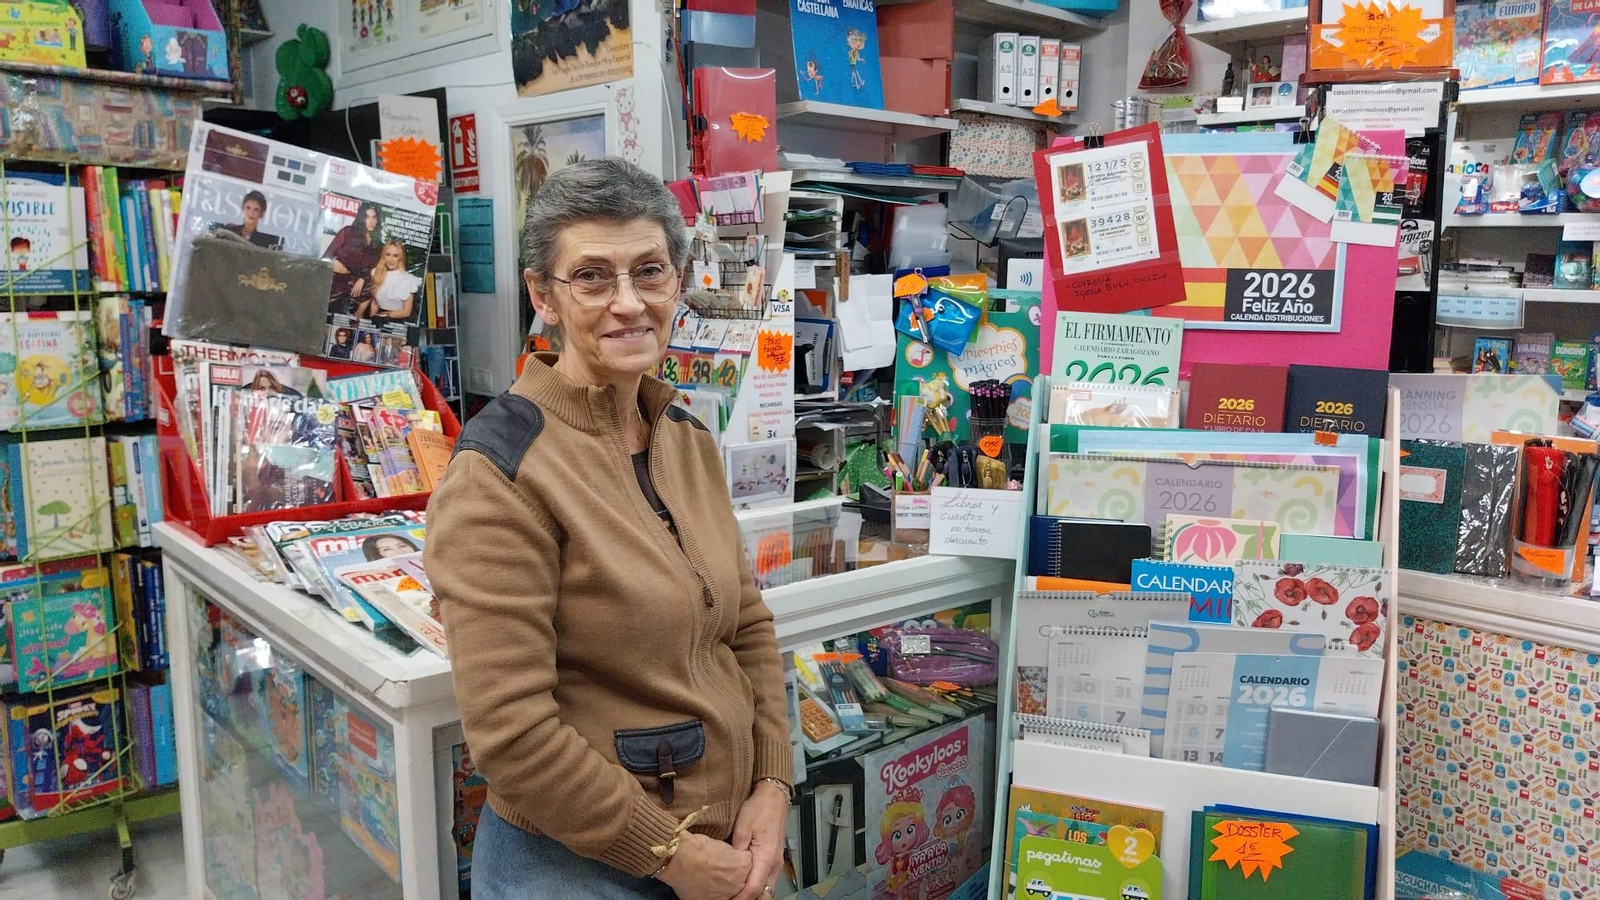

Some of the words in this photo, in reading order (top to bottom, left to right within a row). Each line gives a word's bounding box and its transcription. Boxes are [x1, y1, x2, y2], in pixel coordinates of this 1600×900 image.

[797, 0, 839, 18] CASTELLANA
[1500, 3, 1536, 17] EUROPA
[1332, 106, 1425, 114] cosstorremolinos@gmail.com
[1087, 158, 1127, 173] 12175
[0, 200, 56, 216] VISIBLE
[1090, 212, 1130, 227] 39428
[1400, 229, 1432, 244] ergizer
[1243, 271, 1315, 299] 2026
[772, 304, 791, 313] VISA
[1242, 298, 1279, 313] Feliz
[1281, 299, 1314, 313] Año
[1230, 313, 1264, 321] CALENDA
[1265, 314, 1325, 323] DISTRIBUCIONES
[1065, 321, 1081, 339] EL
[1083, 323, 1171, 346] FIRMAMENTO
[182, 344, 292, 364] THERMOX
[957, 338, 1017, 362] Unicornios
[1074, 345, 1115, 354] CALENDARIO
[1116, 347, 1160, 357] ZARAGOZANO
[1517, 344, 1550, 354] VIAJEROS
[664, 356, 679, 381] 36
[719, 359, 737, 387] 42
[963, 355, 1016, 378] mágicos
[1400, 390, 1456, 400] LANNING
[1218, 397, 1254, 411] 2026
[1315, 401, 1353, 415] 2026
[1203, 413, 1266, 426] DIETARIO
[1300, 416, 1365, 432] DIETARIO
[1400, 414, 1451, 434] 2026
[766, 430, 778, 439] 3€
[1154, 477, 1223, 490] CALENDARIO
[1159, 491, 1217, 513] 2026
[940, 513, 984, 522] cuentos
[351, 566, 402, 585] mar
[1137, 573, 1232, 595] CALENDAR
[1239, 675, 1310, 686] CALENDARIO
[1073, 682, 1096, 694] 30
[1115, 685, 1131, 699] 31
[1236, 685, 1307, 707] 2026
[1077, 705, 1088, 718] 6
[1116, 711, 1127, 723] 7
[1186, 704, 1208, 716] 30
[1188, 727, 1198, 739] 6
[1215, 728, 1224, 739] 7
[1183, 750, 1199, 762] 13
[1208, 752, 1224, 764] 14
[882, 739, 961, 792] Kookyloos
[1068, 829, 1087, 843] LOS
[1225, 823, 1283, 840] DOSSIER
[1124, 836, 1138, 856] 2
[1235, 841, 1257, 854] 1€
[1026, 850, 1102, 869] pegatinas
[1396, 872, 1439, 893] SCUCHA
